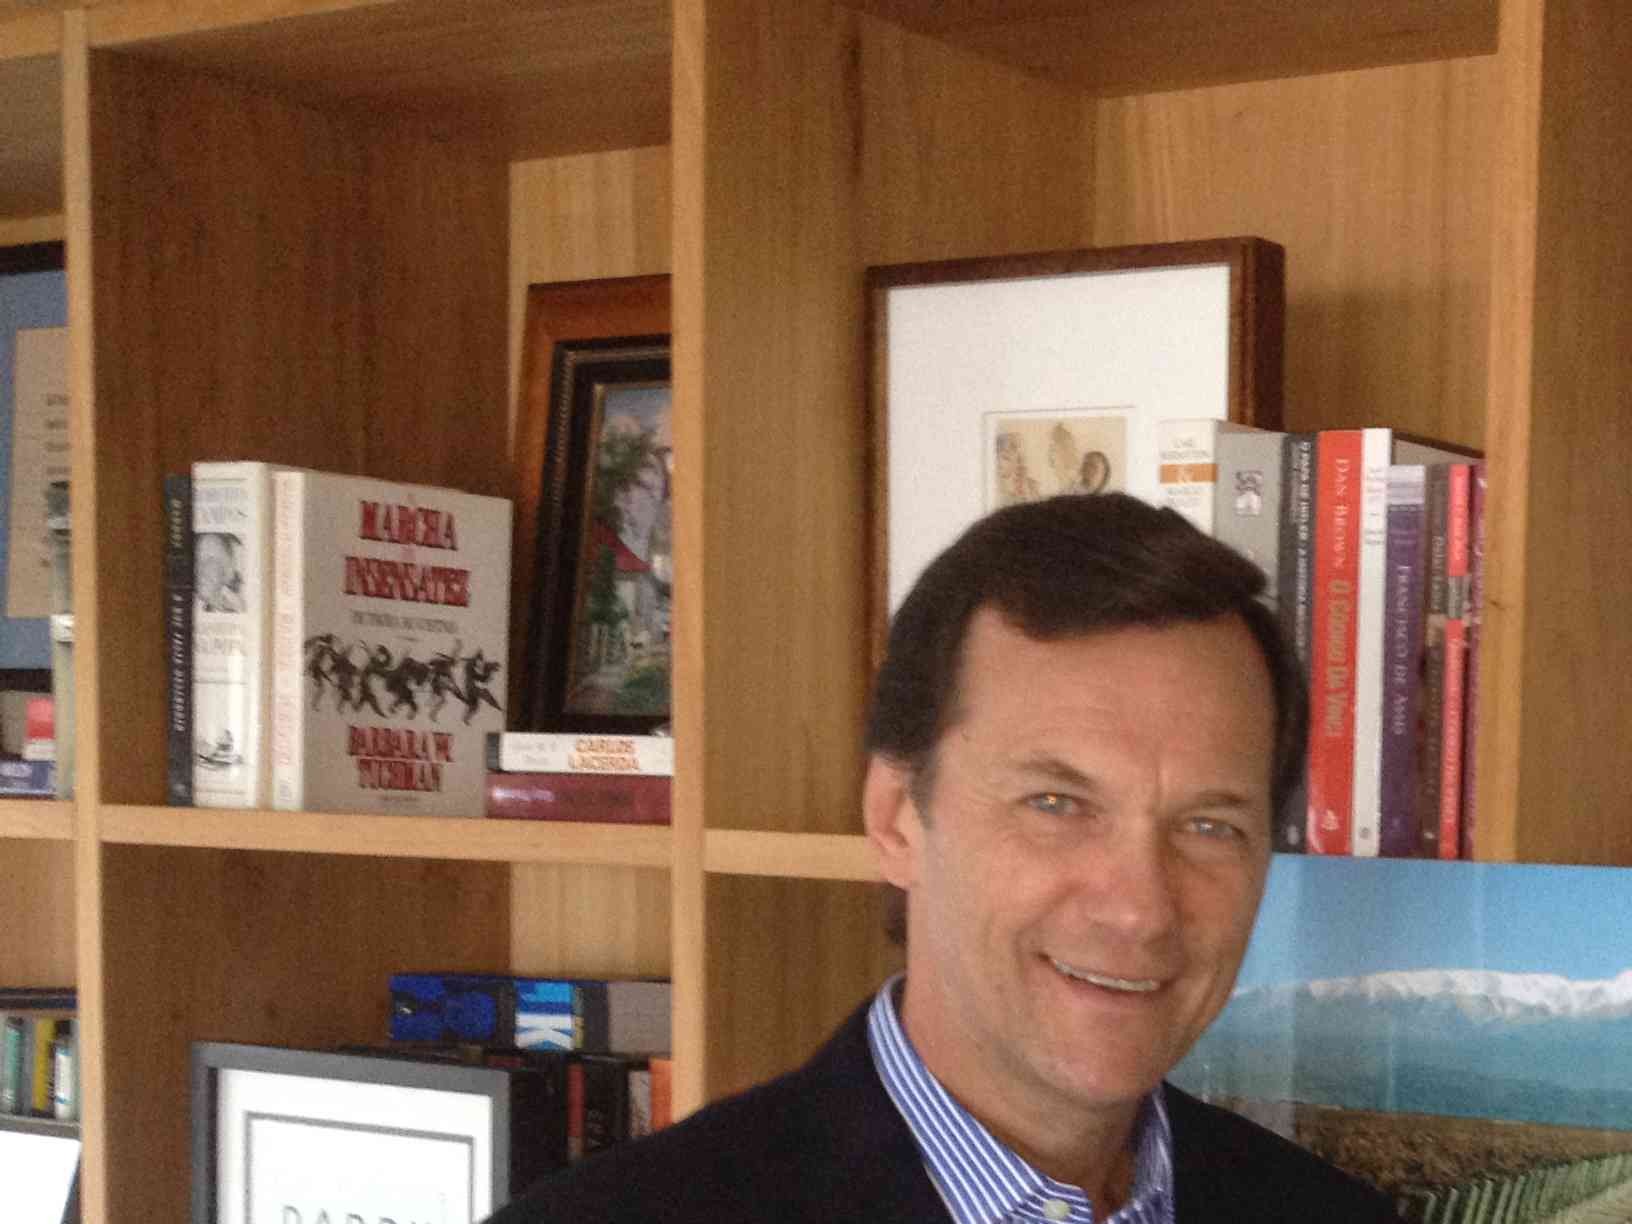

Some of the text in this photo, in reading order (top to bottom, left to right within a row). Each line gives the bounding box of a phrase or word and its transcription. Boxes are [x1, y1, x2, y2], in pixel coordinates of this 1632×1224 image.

[1333, 457, 1349, 568] DAN BROWN
[1329, 579, 1350, 593] O
[1393, 564, 1411, 659] FRANCISCO
